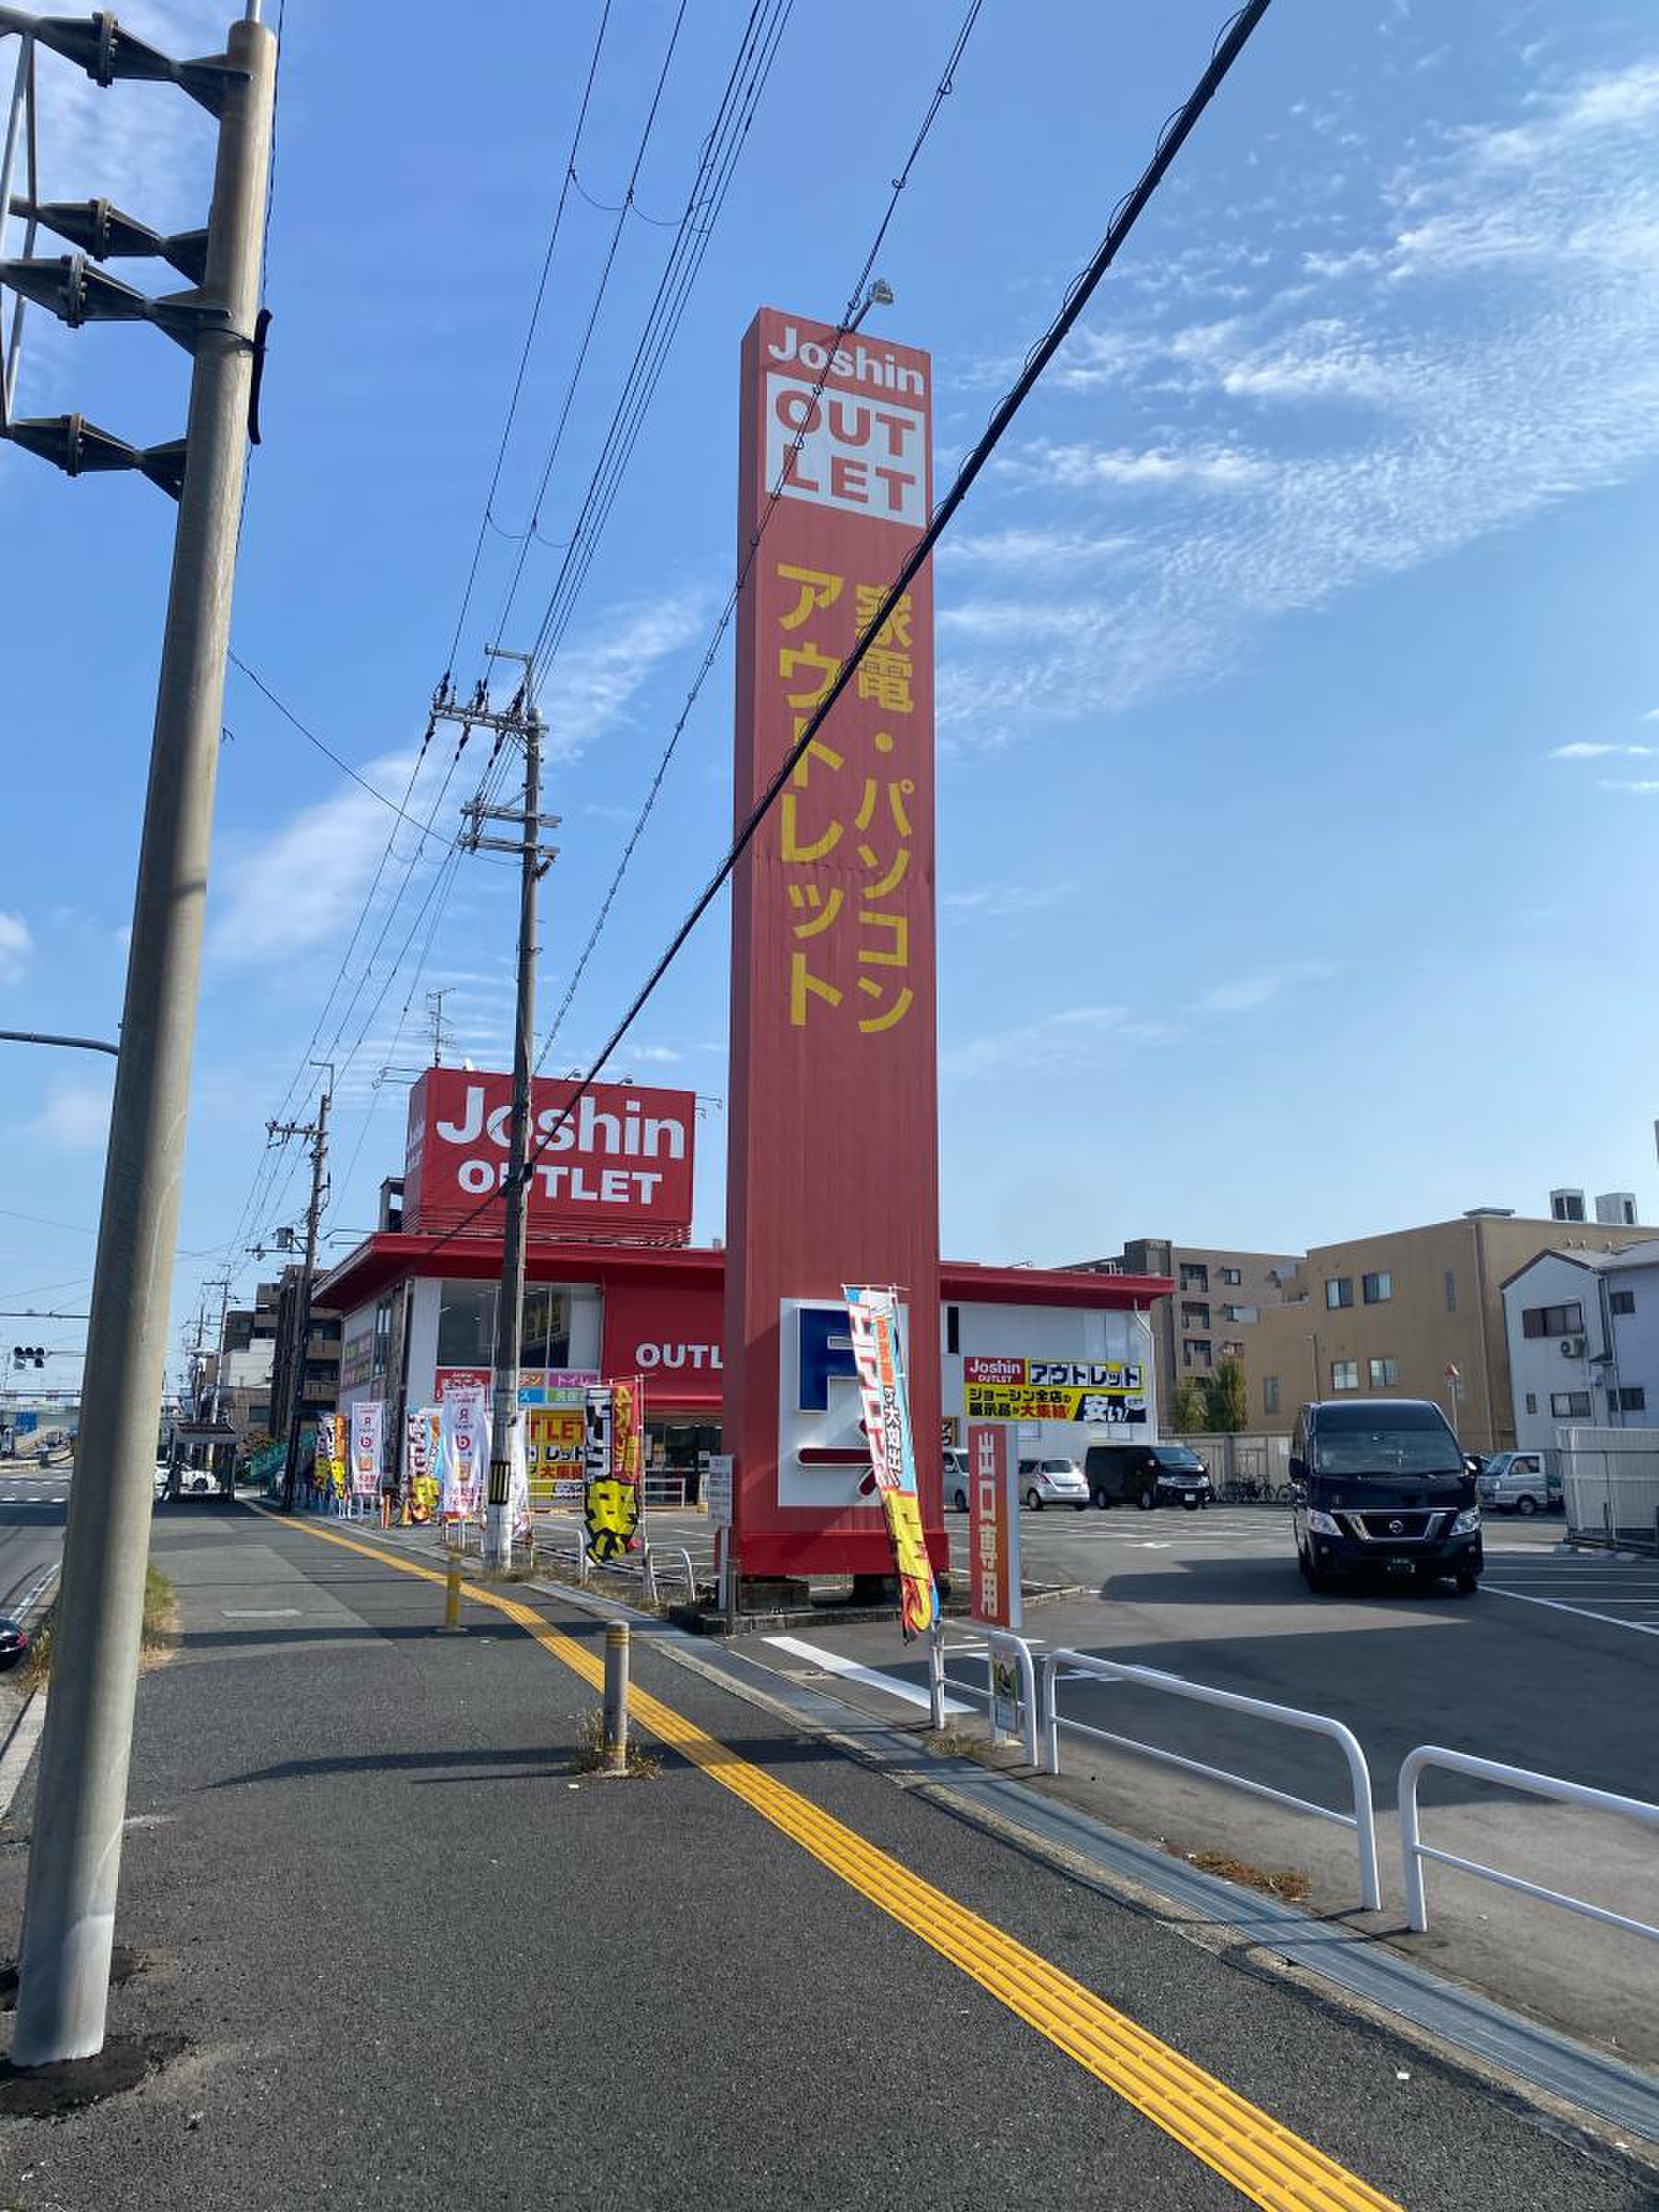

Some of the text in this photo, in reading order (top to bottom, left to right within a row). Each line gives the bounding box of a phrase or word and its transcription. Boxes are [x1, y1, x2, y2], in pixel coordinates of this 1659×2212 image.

[768, 325, 924, 396] Joshin
[775, 389, 915, 458] OUT
[782, 443, 915, 512] LET
[776, 562, 844, 1027] アウトレット
[854, 582, 915, 1033] 家電・パソコン
[635, 1342, 724, 1369] OUTL
[969, 1359, 1021, 1374] Joshin
[1031, 1364, 1138, 1387] アウトレット
[977, 1430, 998, 1618] 出口専用
